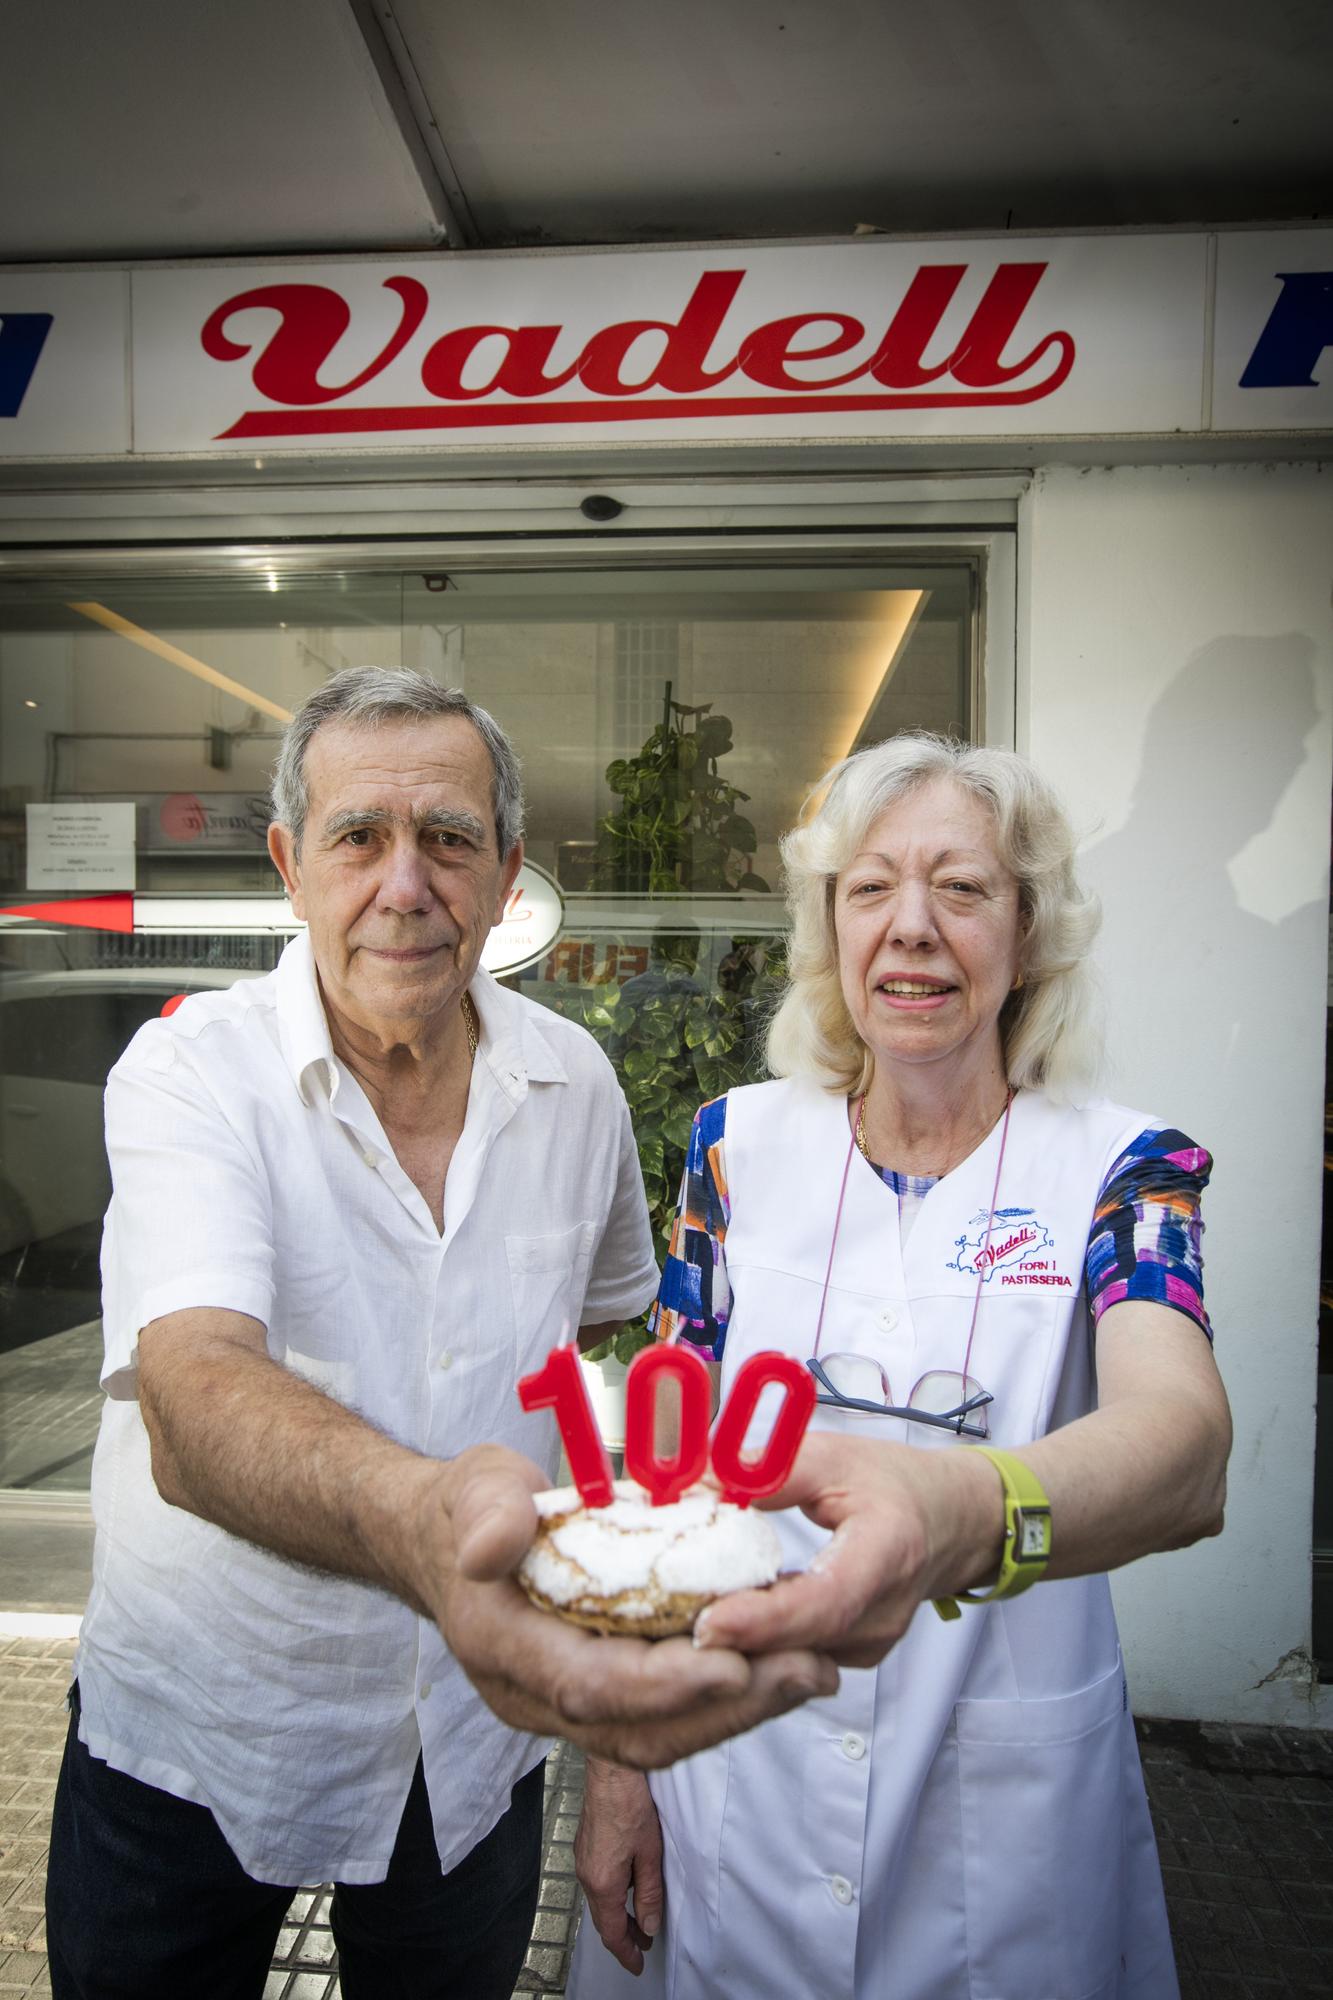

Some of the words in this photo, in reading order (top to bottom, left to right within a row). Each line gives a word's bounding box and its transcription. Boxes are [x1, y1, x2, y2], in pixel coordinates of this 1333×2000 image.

[201, 262, 1076, 438] Vadell
[974, 1227, 1037, 1267] Vadell
[1019, 1261, 1048, 1271] FORN
[1001, 1275, 1072, 1287] PASTISSERIA
[517, 1341, 817, 1510] 100
